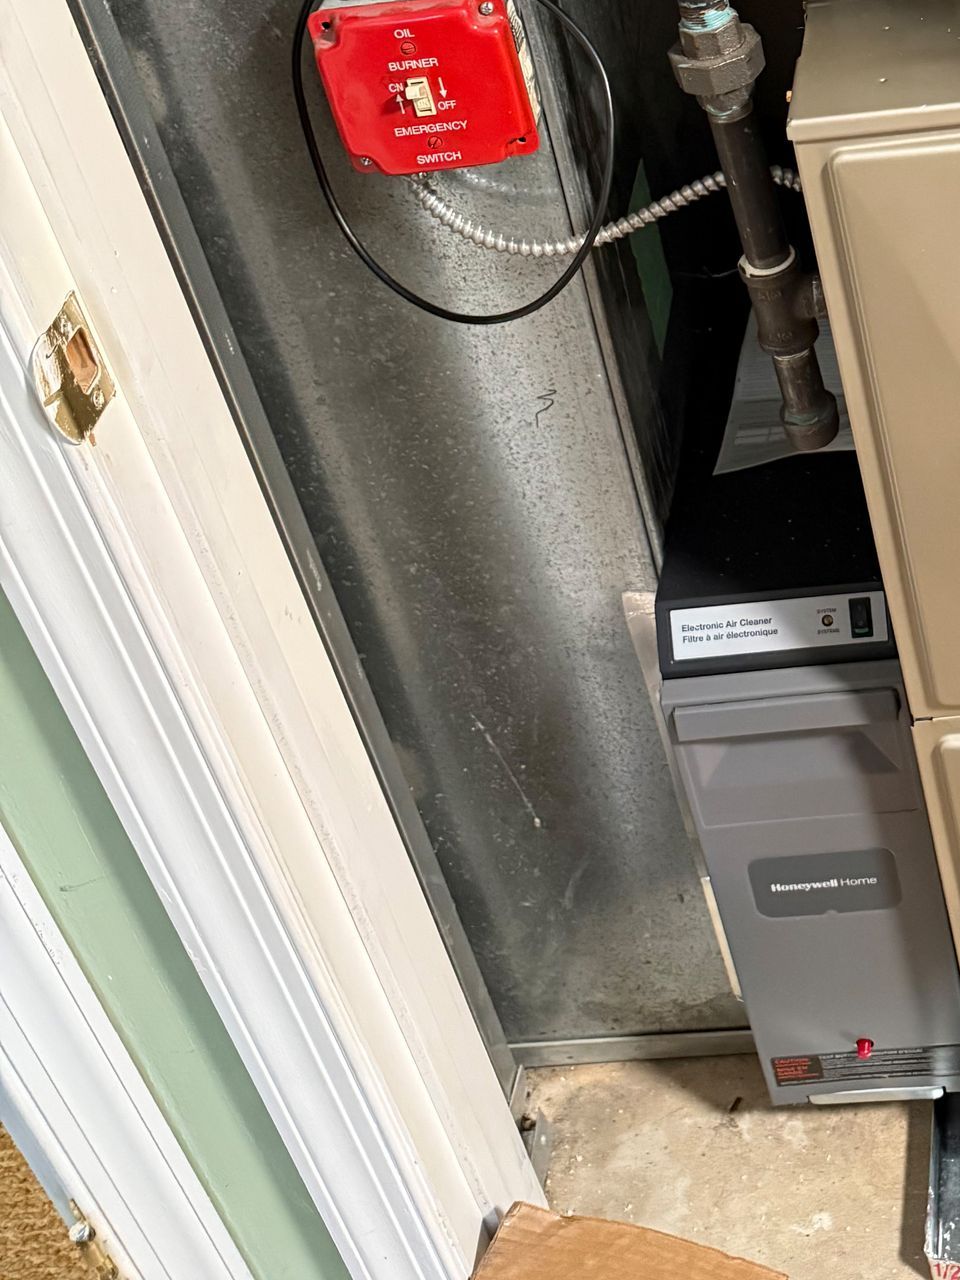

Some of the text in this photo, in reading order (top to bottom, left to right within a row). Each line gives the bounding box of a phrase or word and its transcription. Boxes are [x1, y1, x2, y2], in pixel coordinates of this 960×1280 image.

[394, 29, 415, 39] OIL
[388, 58, 439, 71] BURNER
[437, 100, 457, 111] OFF
[394, 120, 468, 137] EMERGENCY
[416, 151, 462, 165] SWITCH
[681, 617, 773, 633] Electronic Air Cleaner
[682, 634, 704, 644] Filtre
[713, 631, 725, 641] air
[726, 627, 779, 641] électronique
[771, 876, 878, 893] Honeywell Home
